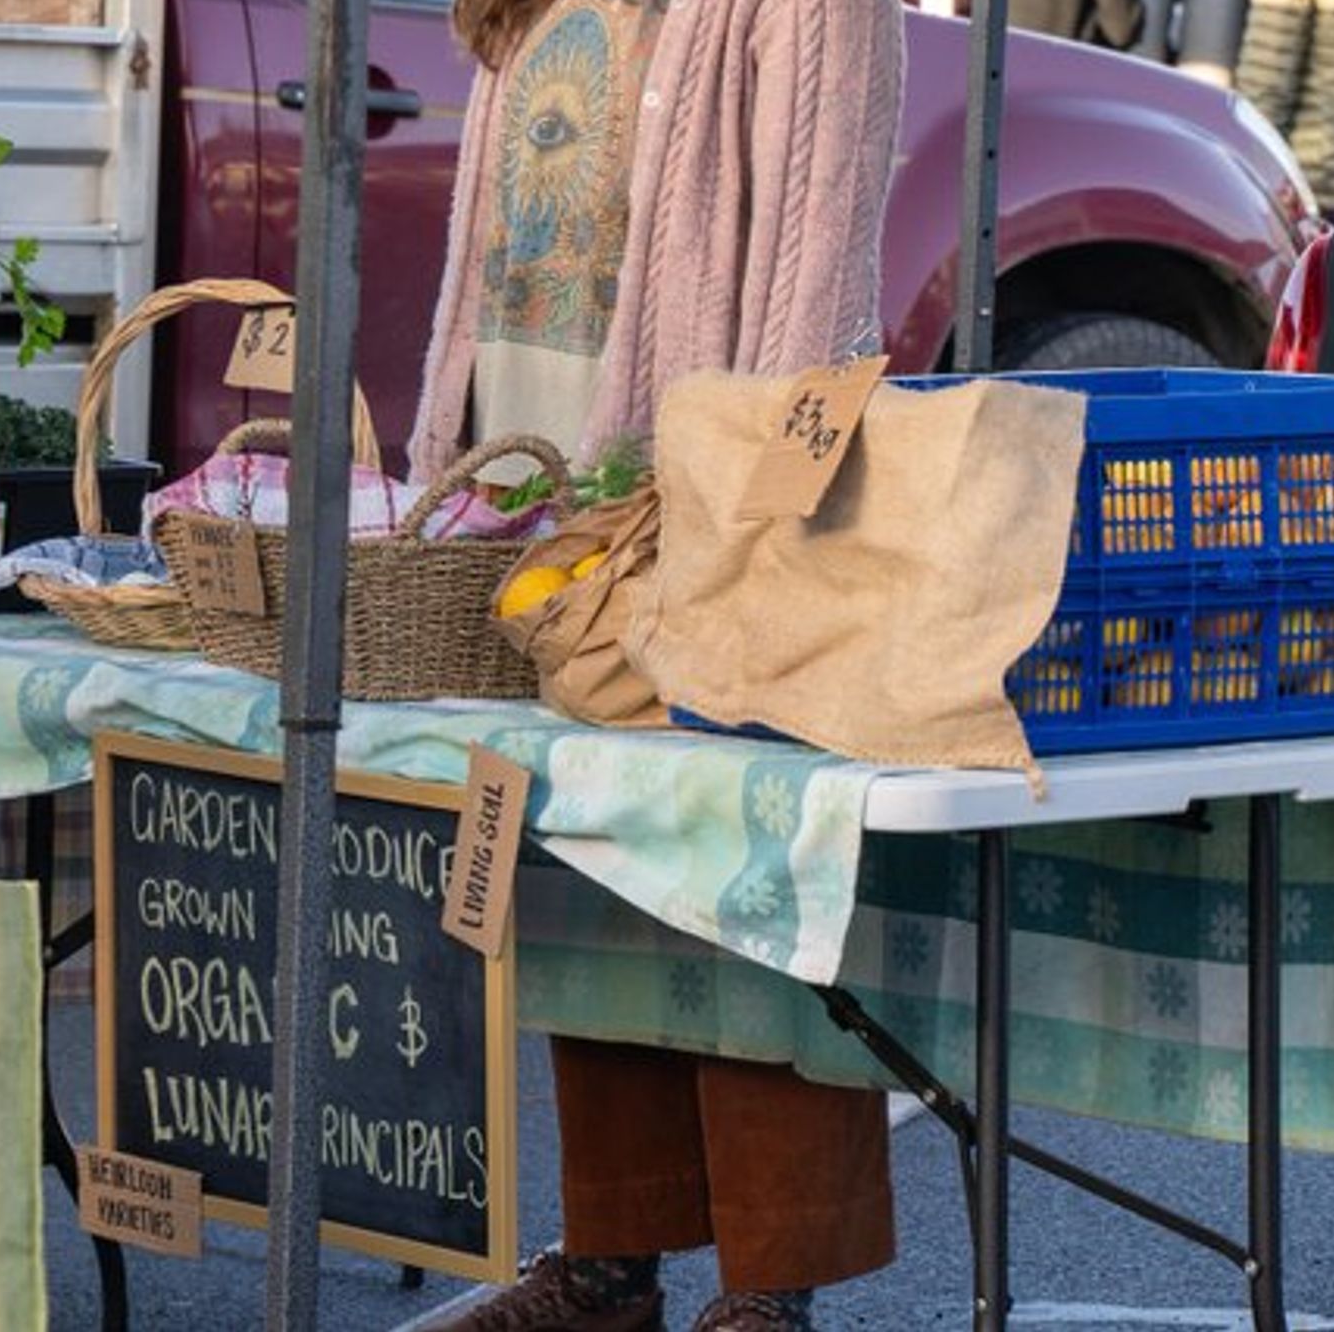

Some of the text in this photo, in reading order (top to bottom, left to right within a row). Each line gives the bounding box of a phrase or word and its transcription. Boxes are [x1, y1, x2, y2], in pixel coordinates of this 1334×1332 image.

[131, 771, 278, 863] GARDEN
[138, 878, 256, 942] GROWN
[459, 846, 495, 929] LIVING
[322, 1104, 489, 1209] RINCIPALS
